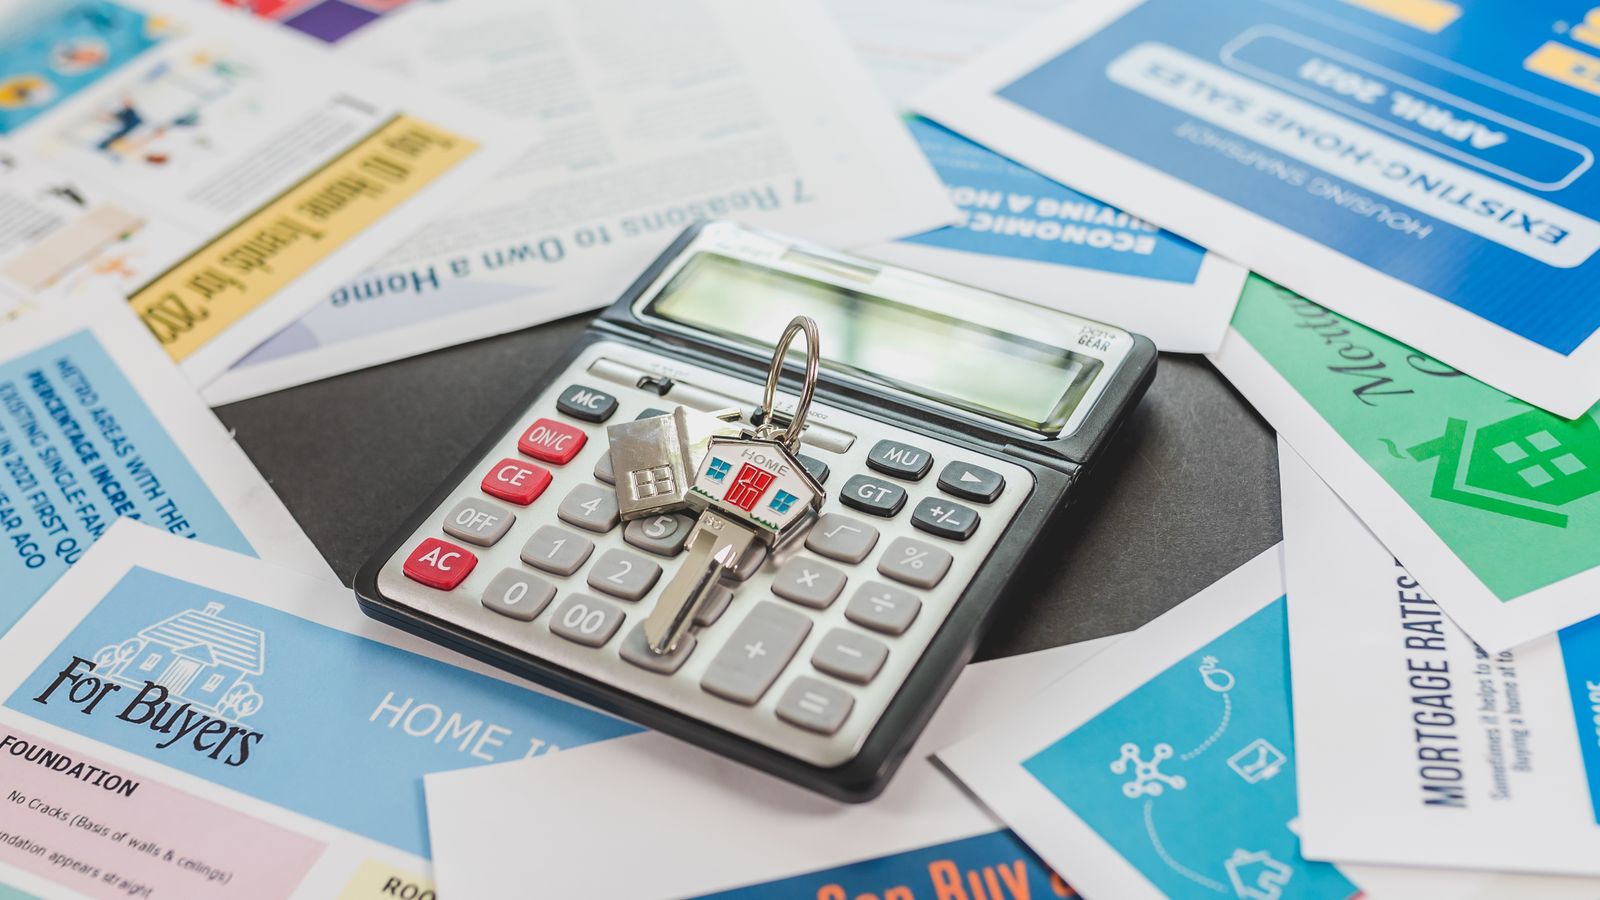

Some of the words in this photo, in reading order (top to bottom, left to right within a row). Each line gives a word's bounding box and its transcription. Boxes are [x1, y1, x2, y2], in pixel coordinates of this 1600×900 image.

[1390, 90, 1508, 149] APRIL
[793, 179, 815, 204] 7
[1256, 109, 1570, 245] EXISTING-HOME
[620, 184, 781, 237] Reasons
[949, 184, 1002, 210] HO
[1007, 193, 1032, 213] A
[1307, 177, 1434, 239] HOUSING
[575, 225, 611, 248] to
[449, 256, 471, 279] a
[482, 236, 566, 269] Own
[330, 265, 440, 308] Home
[1078, 334, 1111, 352] GEAR
[571, 389, 605, 410] MC
[28, 368, 100, 465] PERCENTAGE
[57, 357, 99, 406] METRO
[91, 407, 135, 457] AREAS
[126, 454, 166, 502] WITH
[155, 498, 191, 535] THE
[528, 425, 572, 451] ON/C
[741, 448, 790, 477] HOME
[882, 447, 920, 467] MU
[497, 465, 533, 487] CE
[37, 446, 106, 541] SINGLE-FAM
[581, 497, 600, 516] 4
[857, 483, 892, 502] GT
[0, 488, 23, 533] EAR
[5, 456, 38, 492] 2021
[27, 490, 69, 536] FIRST
[55, 537, 84, 568] QU
[455, 508, 498, 532] OFF
[646, 516, 673, 537] 5
[10, 533, 46, 569] AGO
[418, 548, 460, 571] AC
[550, 539, 565, 559] 1
[608, 561, 632, 584] 2
[503, 582, 528, 605] 0
[563, 603, 605, 634] 00
[1473, 660, 1492, 677] to
[1477, 678, 1498, 712] helps
[1503, 682, 1522, 714] home
[33, 656, 121, 714] For
[115, 680, 264, 767] Buyers
[369, 691, 512, 762] HOME
[1408, 659, 1466, 808] MORTGAGE
[0, 735, 140, 797] FOUNDATION
[1511, 729, 1533, 773] Buying
[7, 790, 26, 805] No
[28, 798, 70, 822] Cracks
[69, 814, 109, 837] (Basis
[111, 831, 128, 843] of
[128, 836, 160, 857] walls
[163, 850, 174, 862] &
[178, 857, 234, 885] ceilings)
[48, 851, 100, 879] appears
[102, 871, 155, 899] straight
